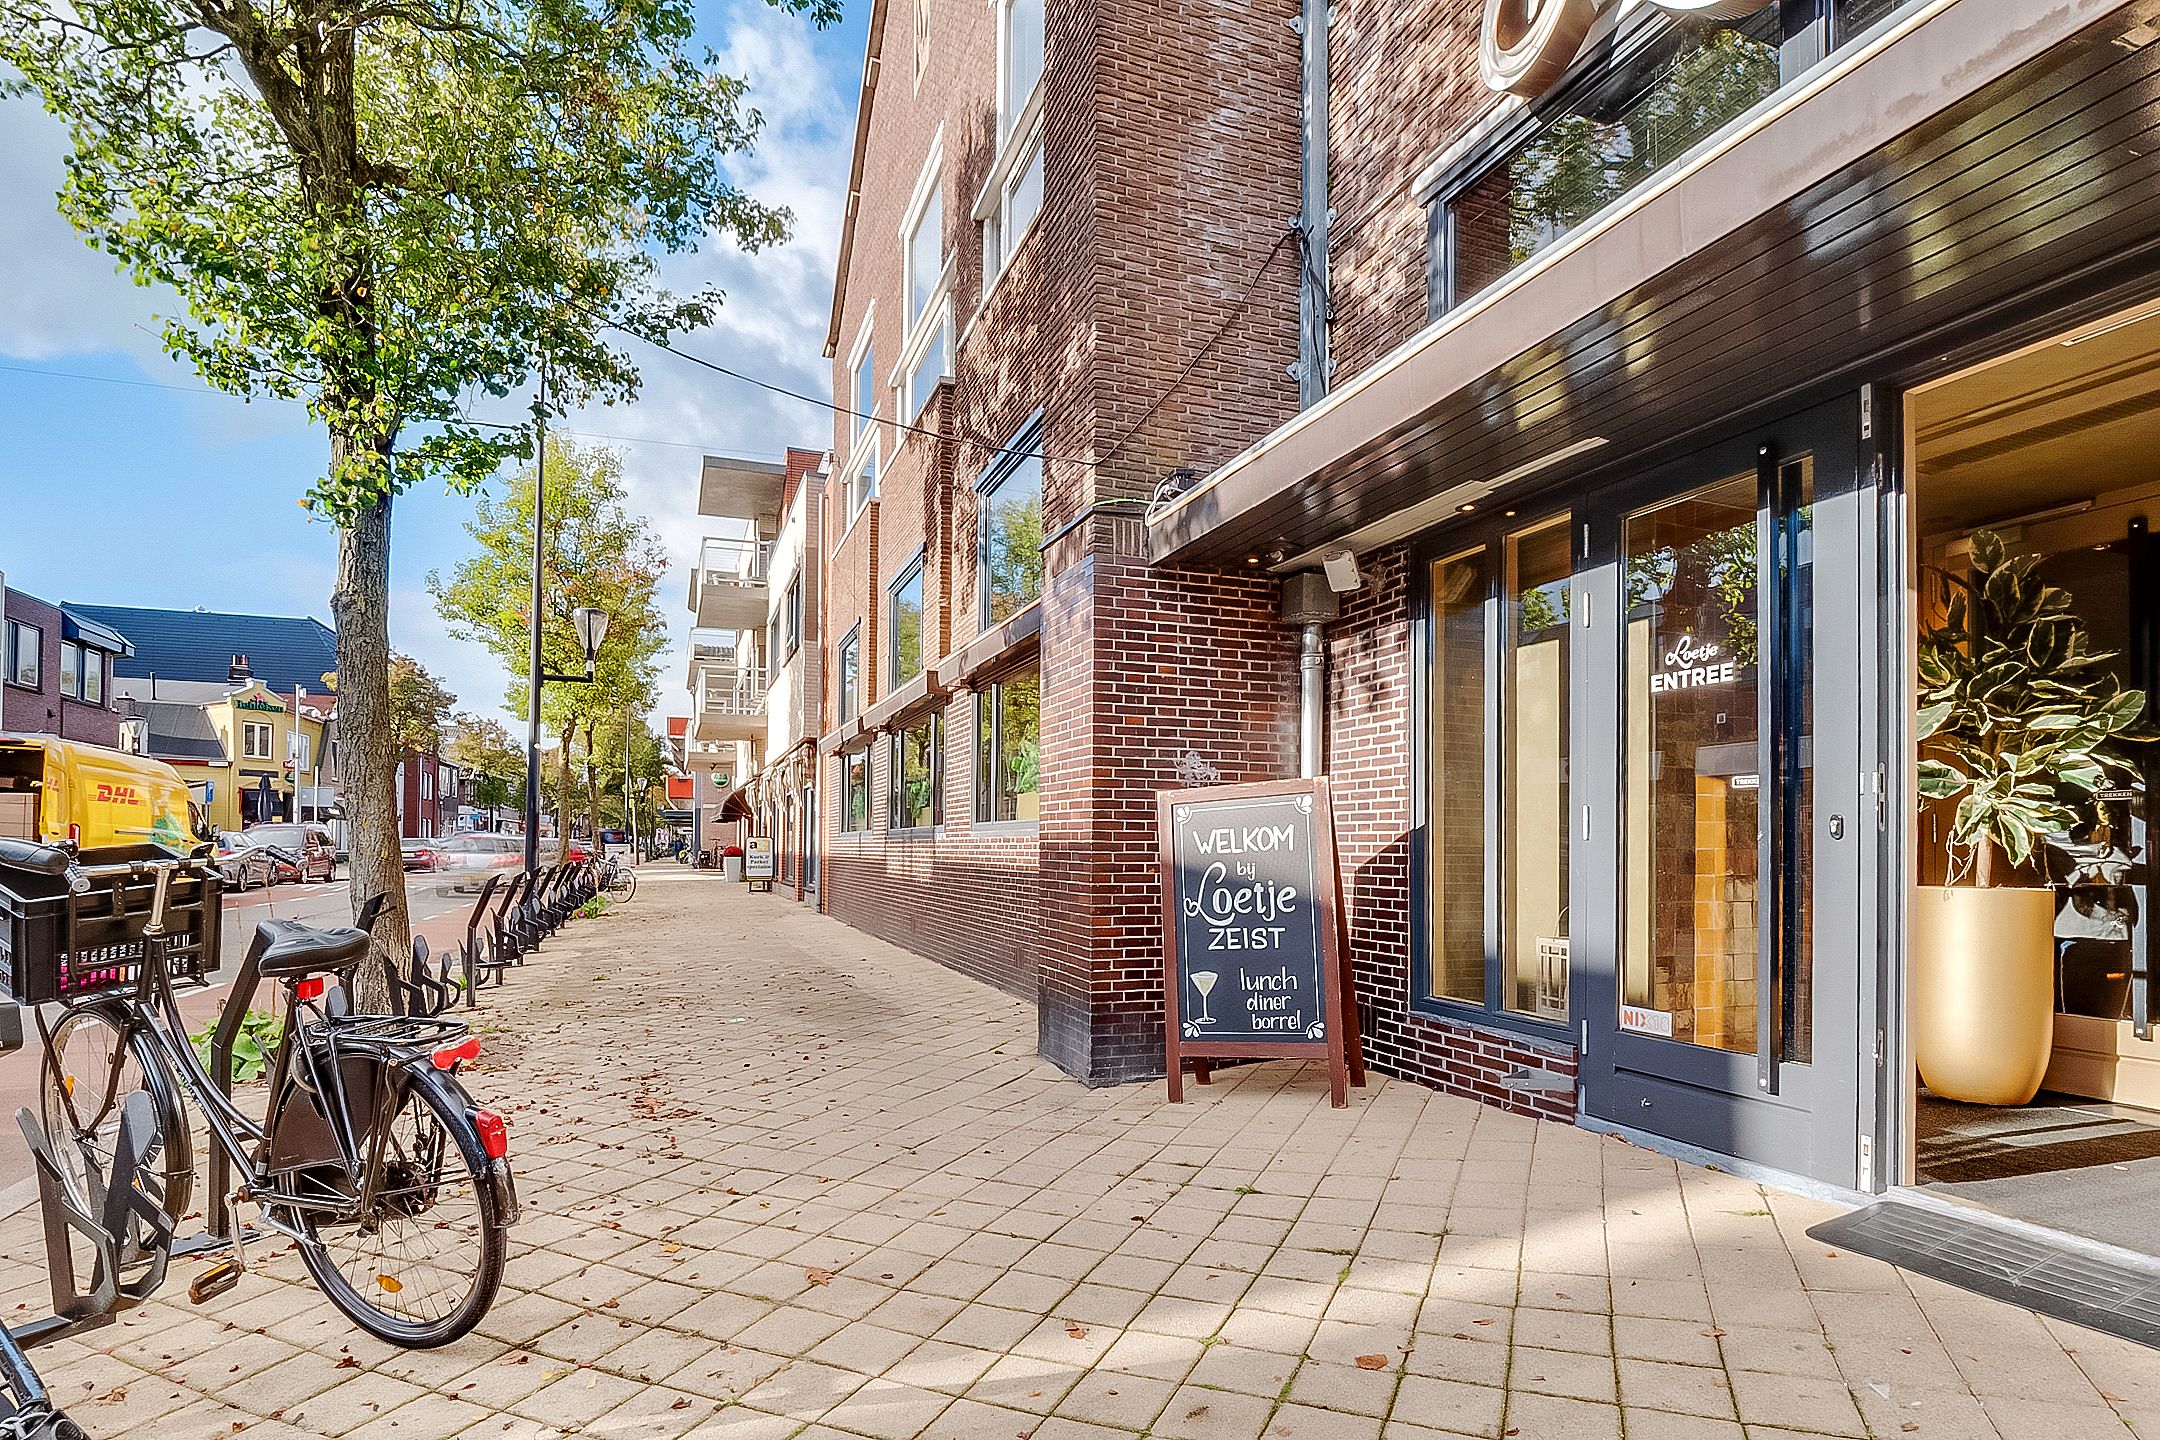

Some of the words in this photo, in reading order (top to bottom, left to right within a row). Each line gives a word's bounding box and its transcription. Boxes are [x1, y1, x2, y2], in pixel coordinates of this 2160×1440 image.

[1665, 635, 1719, 669] Loetje
[1650, 661, 1734, 693] ENTREE
[97, 784, 139, 806] DHL
[1192, 823, 1295, 856] WELKOM
[1183, 861, 1298, 926] Loetje
[1207, 927, 1286, 951] ZEIST
[1239, 965, 1298, 991] lunch
[1246, 993, 1292, 1011] diner
[1251, 1009, 1302, 1030] borrel
